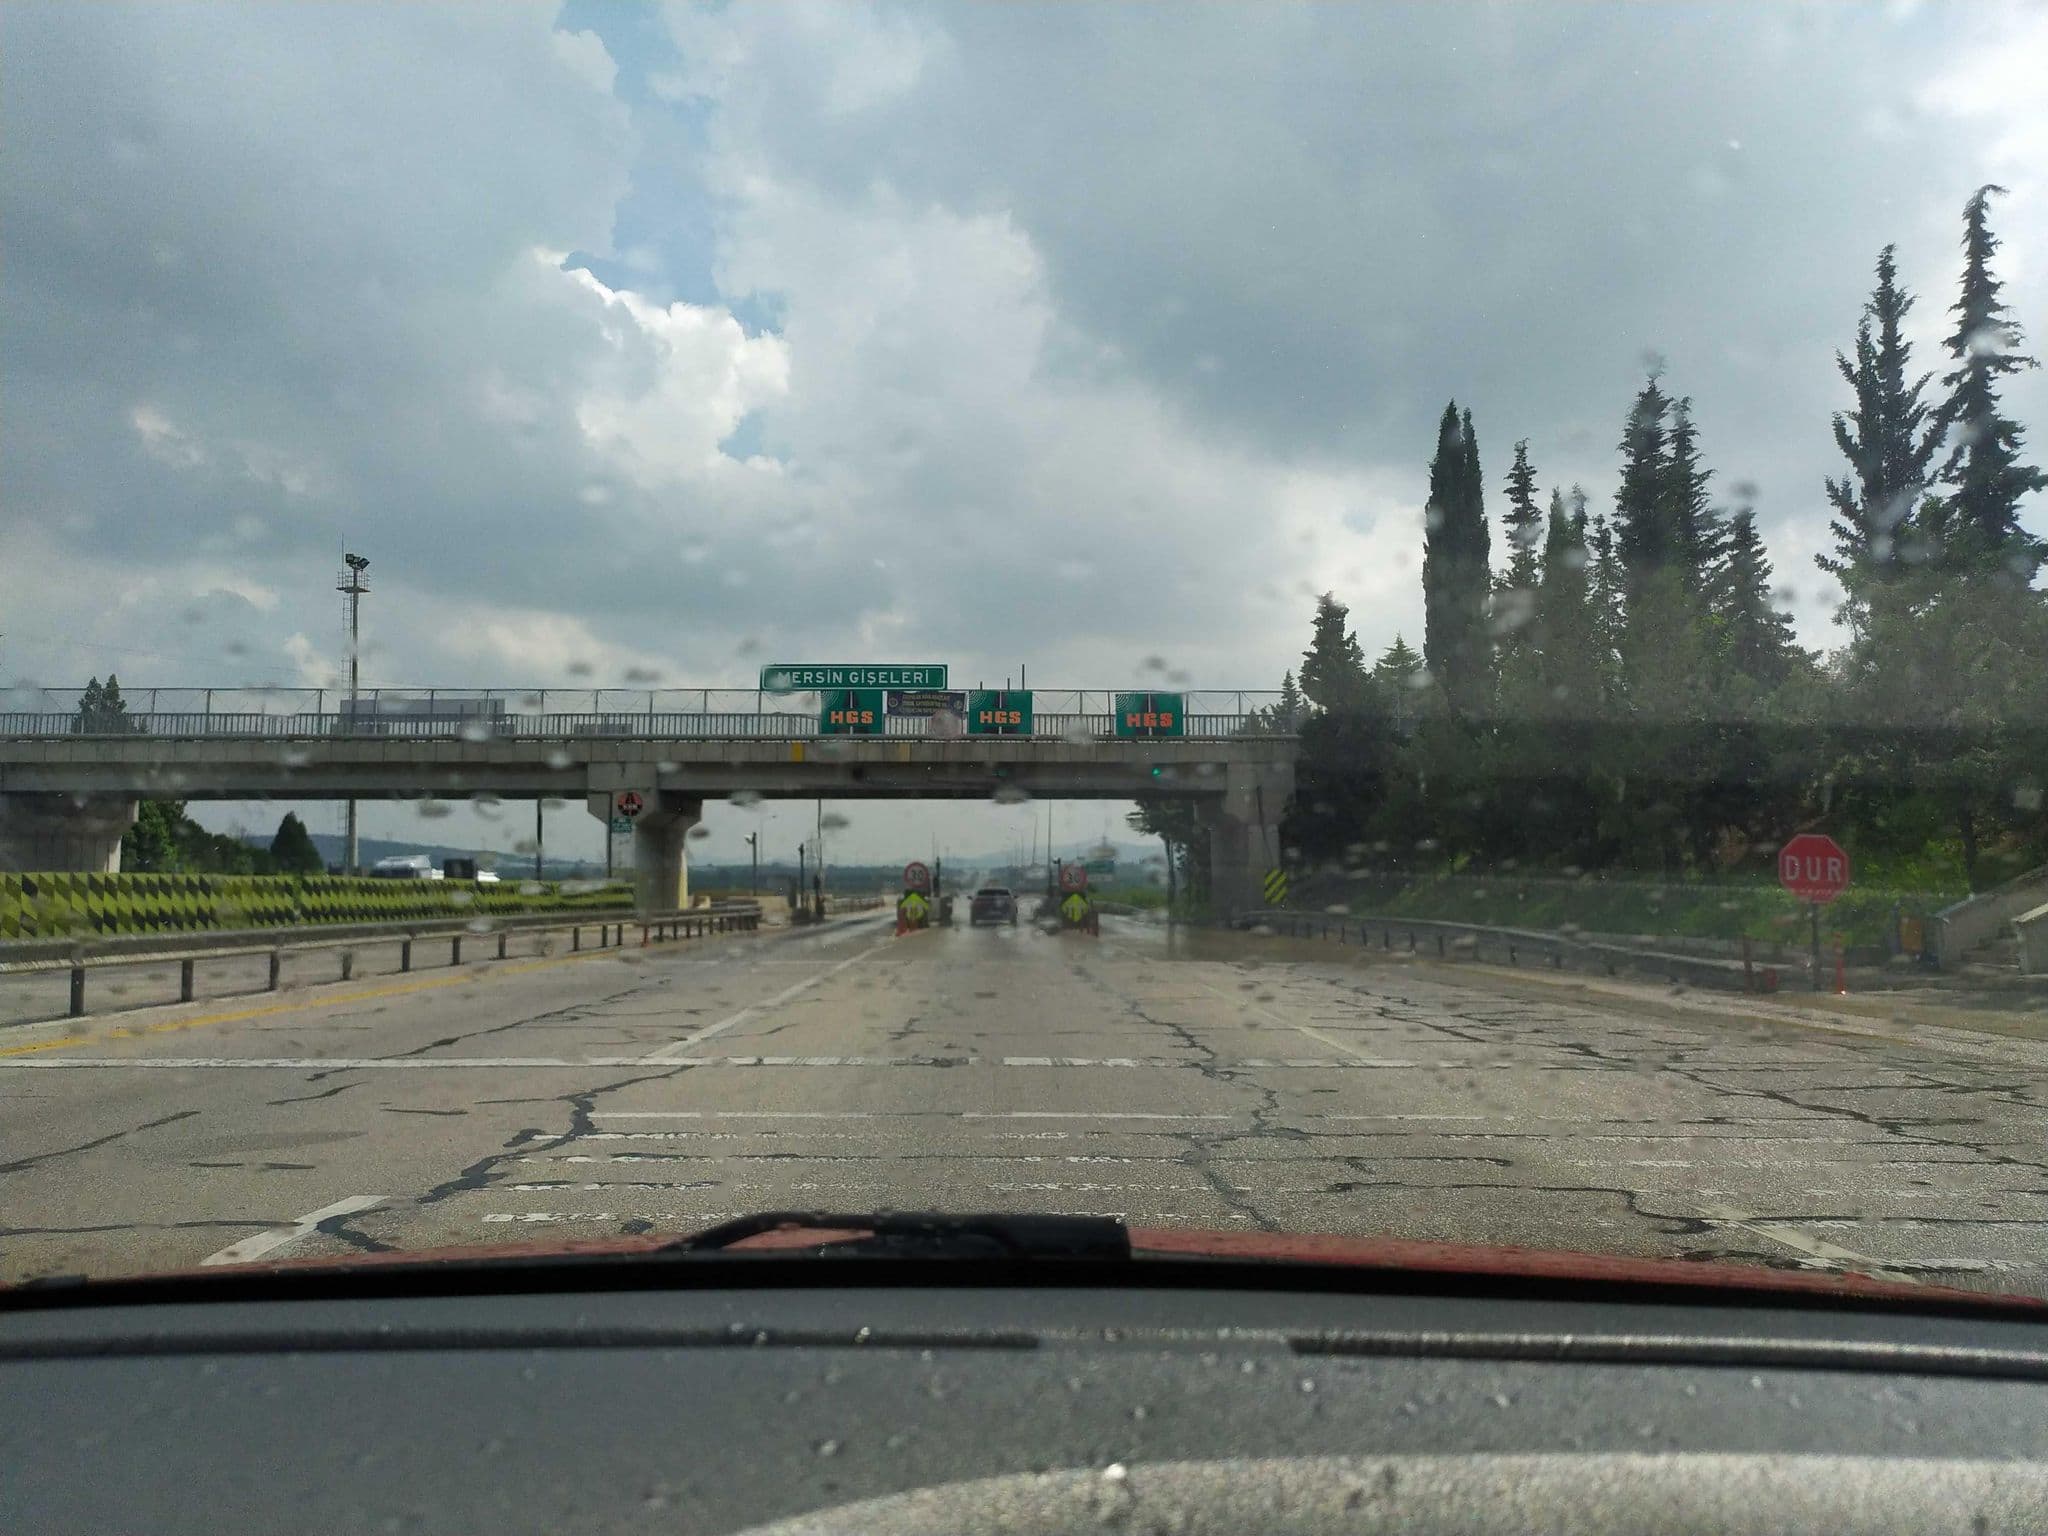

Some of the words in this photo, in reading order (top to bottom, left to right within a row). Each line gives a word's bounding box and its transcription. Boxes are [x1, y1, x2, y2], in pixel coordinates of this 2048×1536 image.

[849, 669, 929, 686] GİŞELERİ
[830, 711, 874, 725] HGS
[979, 710, 1022, 724] HGS
[1126, 712, 1173, 727] HGS
[1785, 855, 1842, 882] DUR
